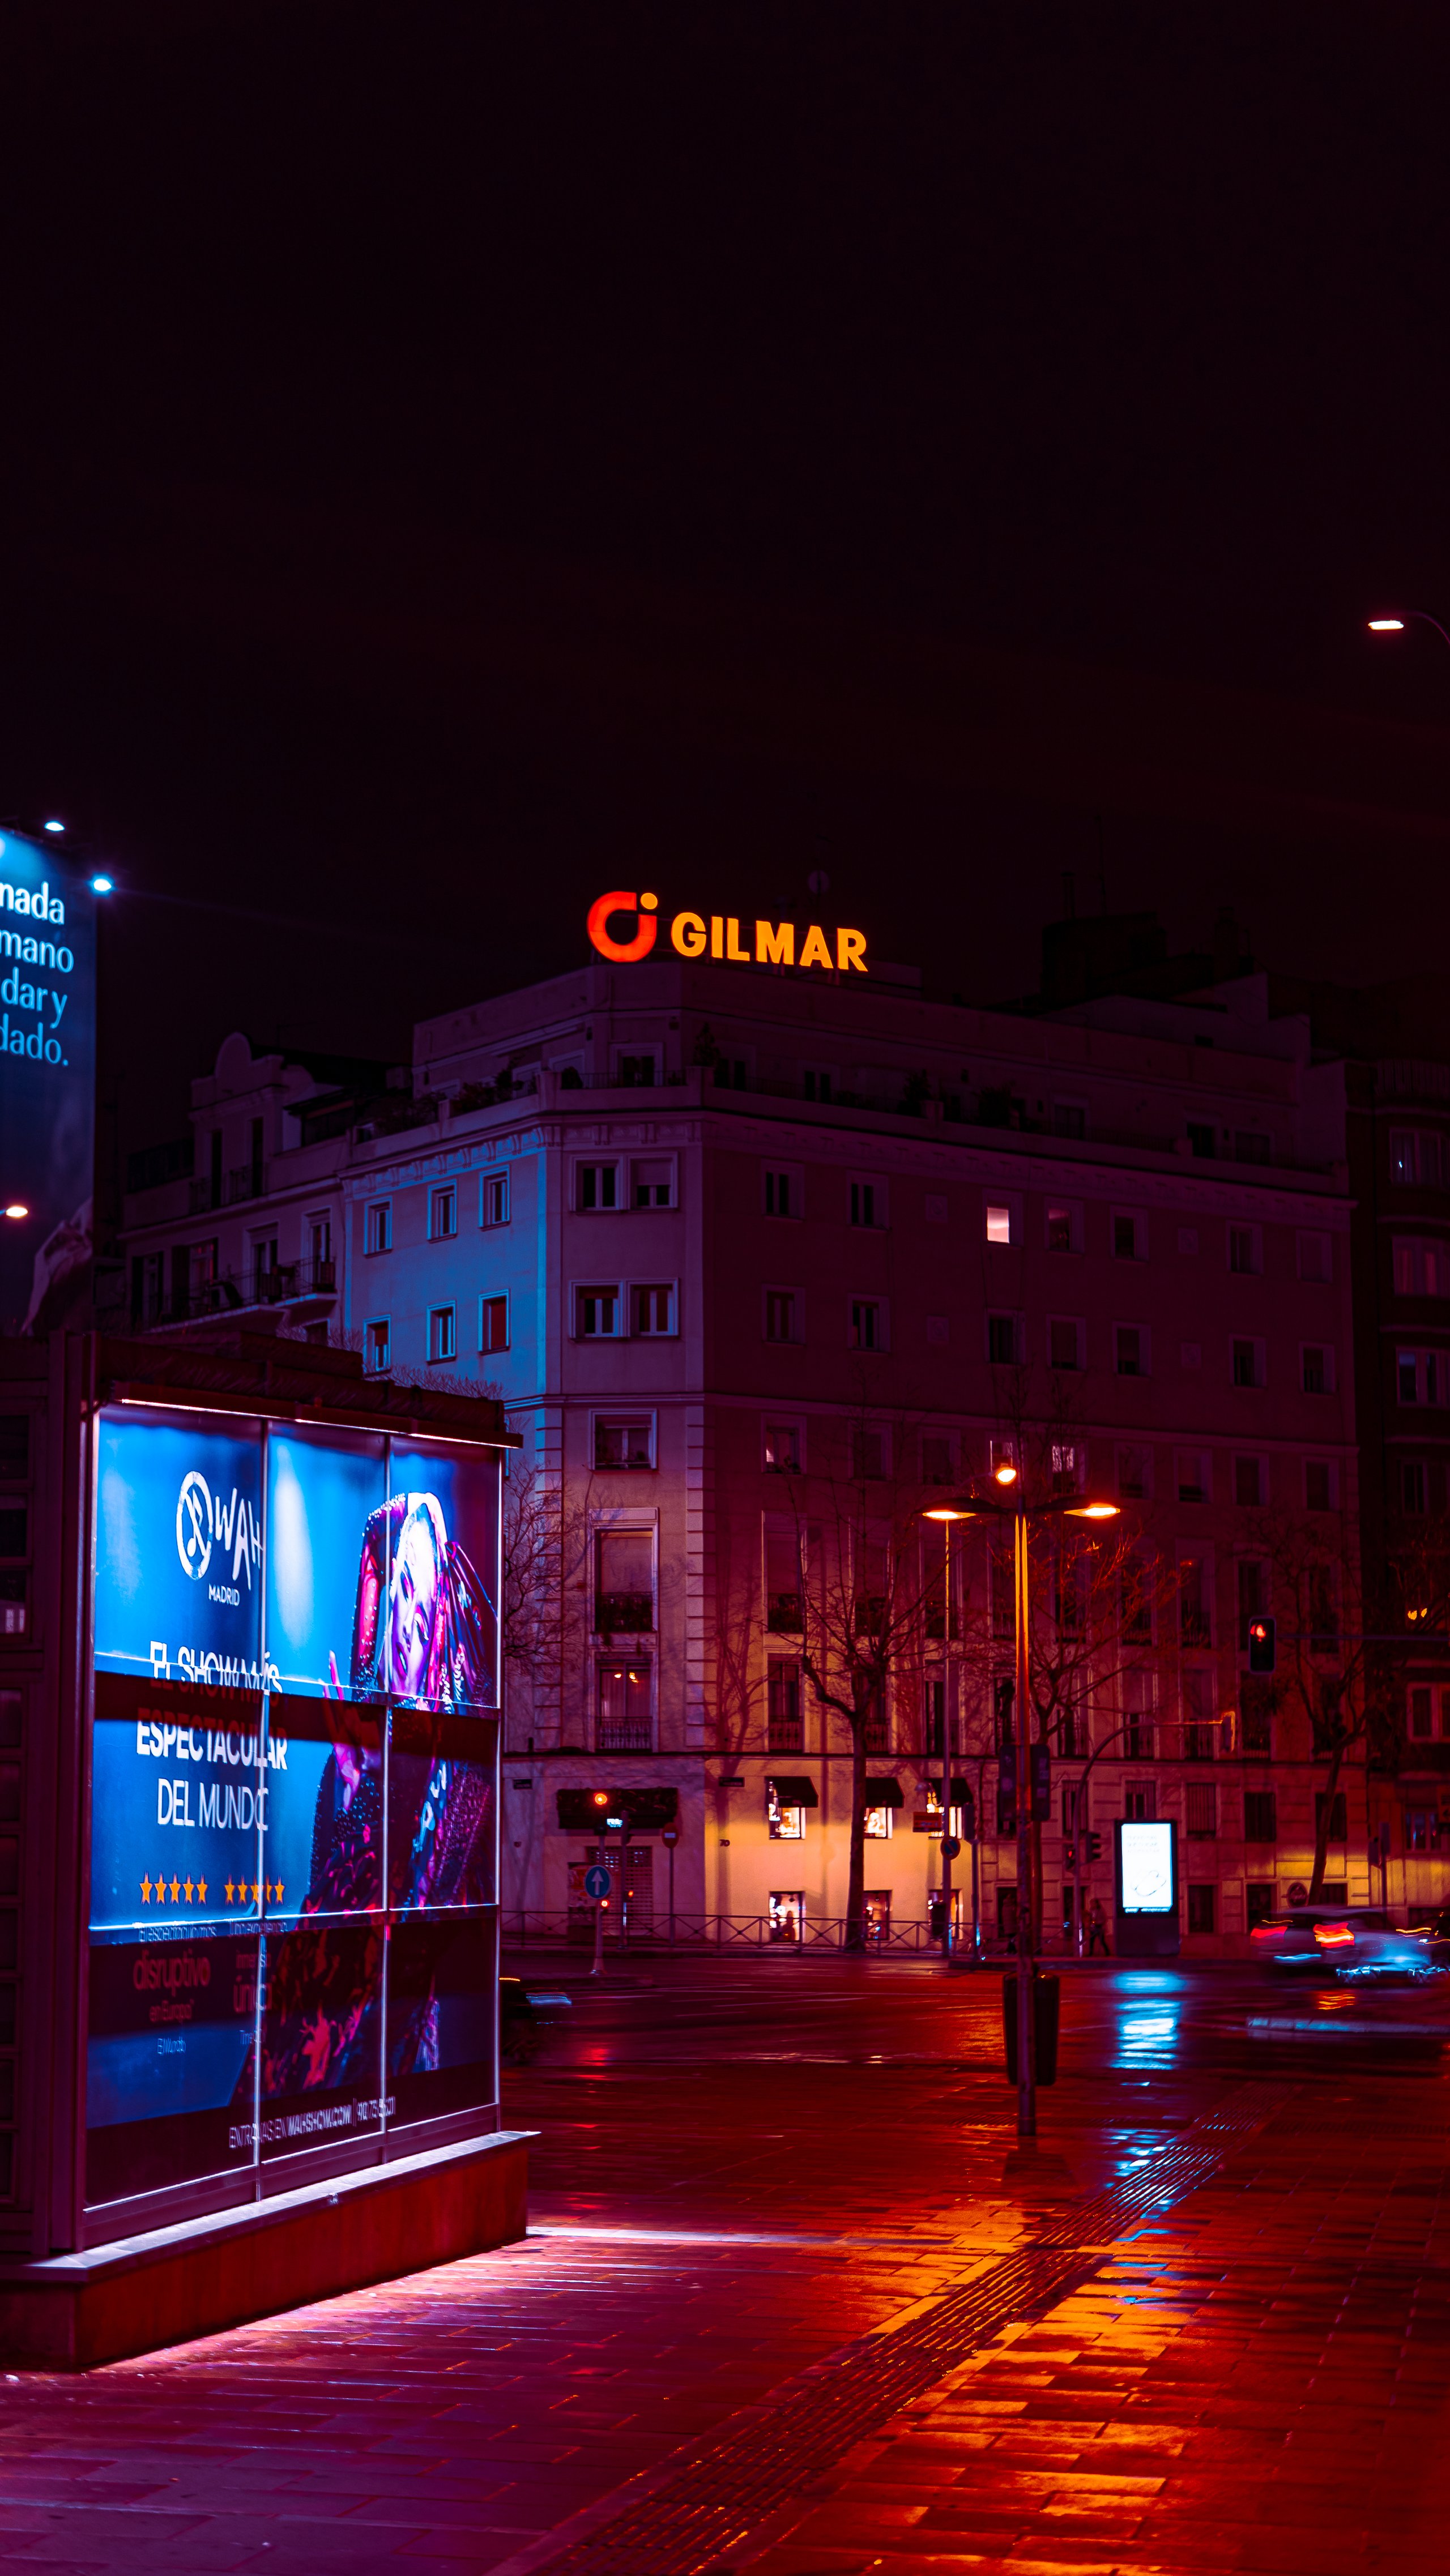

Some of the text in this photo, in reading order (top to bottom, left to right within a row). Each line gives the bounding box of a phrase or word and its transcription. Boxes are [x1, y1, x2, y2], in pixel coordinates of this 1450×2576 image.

[672, 912, 868, 972] GILMAR
[50, 990, 68, 1029] y
[208, 1583, 240, 1607] MADRID
[150, 1641, 173, 1690] EL
[177, 1646, 239, 1700] SHOW
[137, 1707, 288, 1770] ESPECTACULAR
[157, 1778, 195, 1827] DEL
[133, 1949, 211, 1997] disruptivo
